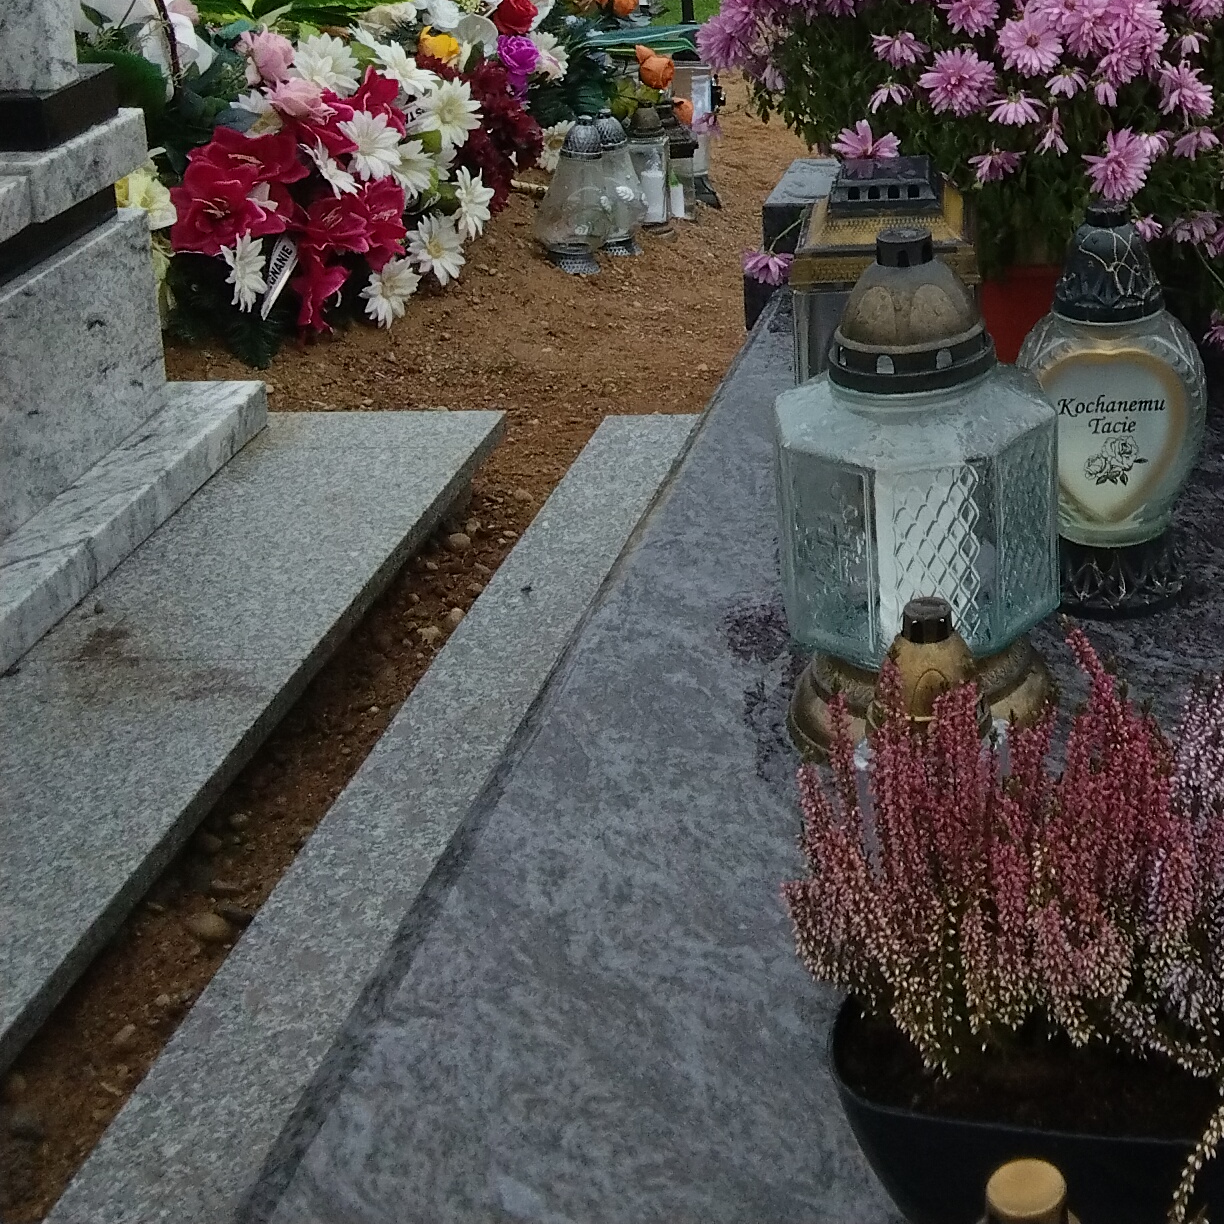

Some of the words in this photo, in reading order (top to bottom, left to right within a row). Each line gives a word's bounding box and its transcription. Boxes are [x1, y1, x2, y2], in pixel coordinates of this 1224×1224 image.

[269, 244, 293, 290] GNANIE
[1057, 394, 1166, 418] Kochanemu
[1088, 416, 1137, 435] Tacie
